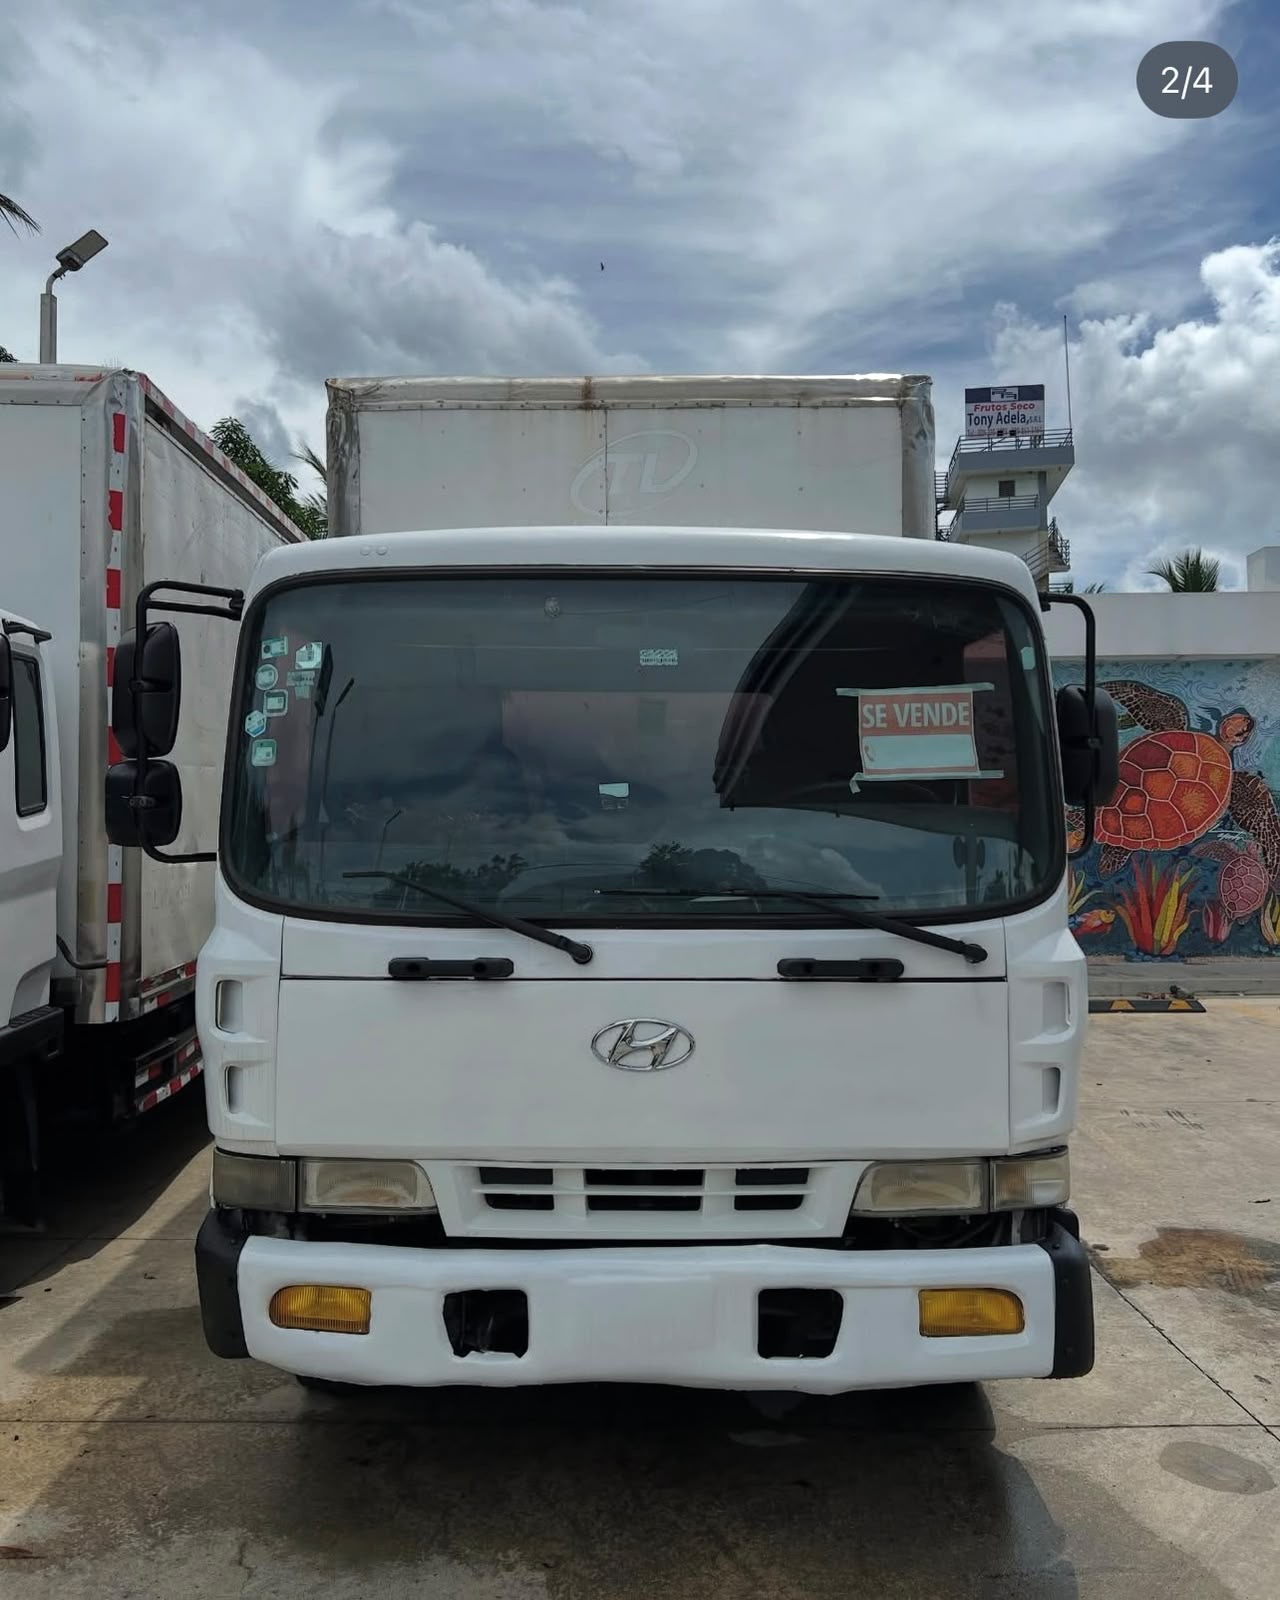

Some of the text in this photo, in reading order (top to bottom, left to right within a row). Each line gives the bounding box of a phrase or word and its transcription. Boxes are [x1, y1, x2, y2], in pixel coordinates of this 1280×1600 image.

[973, 402, 1035, 412] Frutos Seco
[967, 413, 994, 428] Tony
[862, 701, 970, 729] SE VENDE
